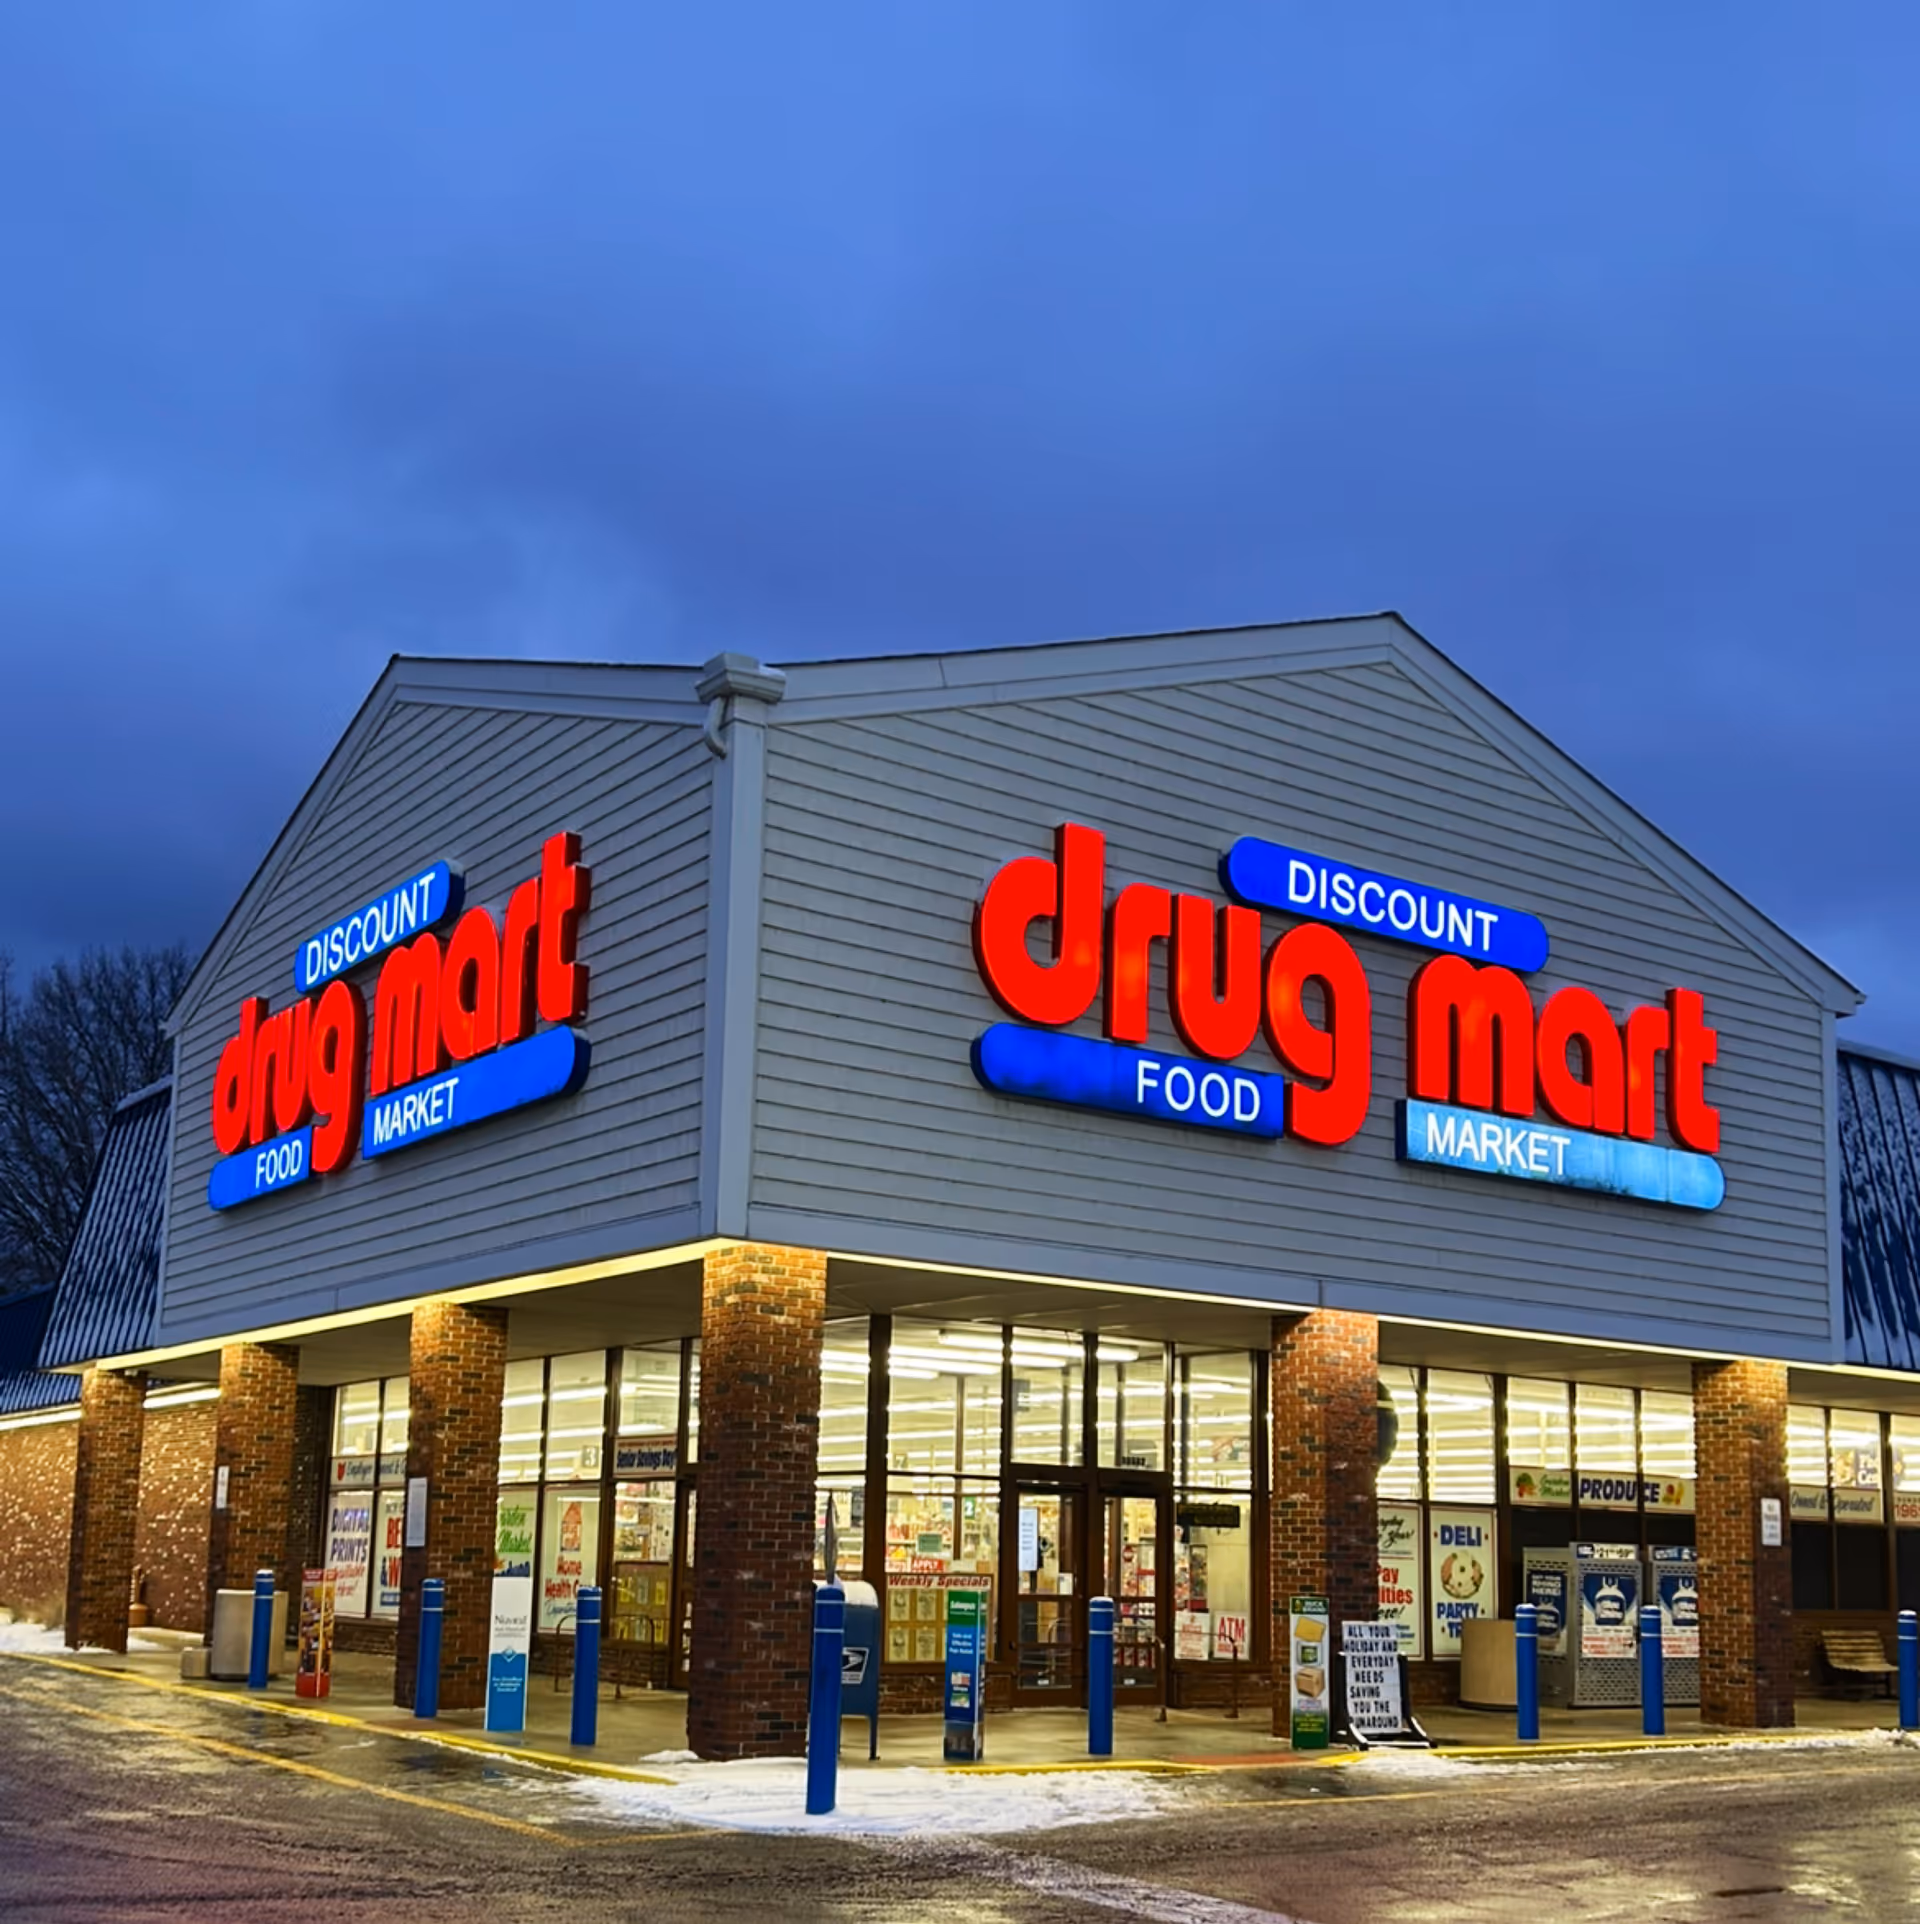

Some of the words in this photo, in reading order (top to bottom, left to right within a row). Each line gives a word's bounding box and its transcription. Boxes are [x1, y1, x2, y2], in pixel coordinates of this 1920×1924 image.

[1288, 859, 1498, 951] DISCOUNT
[306, 872, 436, 985] DISCOUNT
[972, 822, 1371, 1146] drug
[1407, 954, 1720, 1154] mart
[212, 996, 365, 1173] drug
[370, 831, 590, 1097] mart
[1136, 1059, 1261, 1122] FOOD
[373, 1077, 459, 1146] MARKET
[1426, 1113, 1571, 1175] MARKET
[255, 1138, 303, 1189] FOOD
[585, 1446, 597, 1467] 3
[1579, 1478, 1660, 1503] PRODUCE
[331, 1507, 370, 1533] DIGITAL
[964, 1501, 975, 1517] 2
[1440, 1524, 1482, 1547] DELI
[330, 1537, 368, 1562] PRINTS
[557, 1555, 582, 1576] Home
[913, 1559, 939, 1570] APPLY
[544, 1578, 572, 1599] Health
[889, 1575, 934, 1588] Weekly
[937, 1575, 989, 1588] Specials
[1437, 1602, 1479, 1619] PARTY
[1218, 1617, 1245, 1642] ATM
[1348, 1626, 1363, 1638] ALL
[1369, 1627, 1391, 1638] YOUR
[1345, 1641, 1379, 1653] HOLIDAY
[1382, 1641, 1398, 1652] AND
[1351, 1656, 1394, 1669] EVERYDAY
[1354, 1671, 1384, 1684] NEEDS
[1350, 1686, 1381, 1699] SAVING
[1354, 1701, 1371, 1714] YOU
[1374, 1701, 1390, 1714] THE
